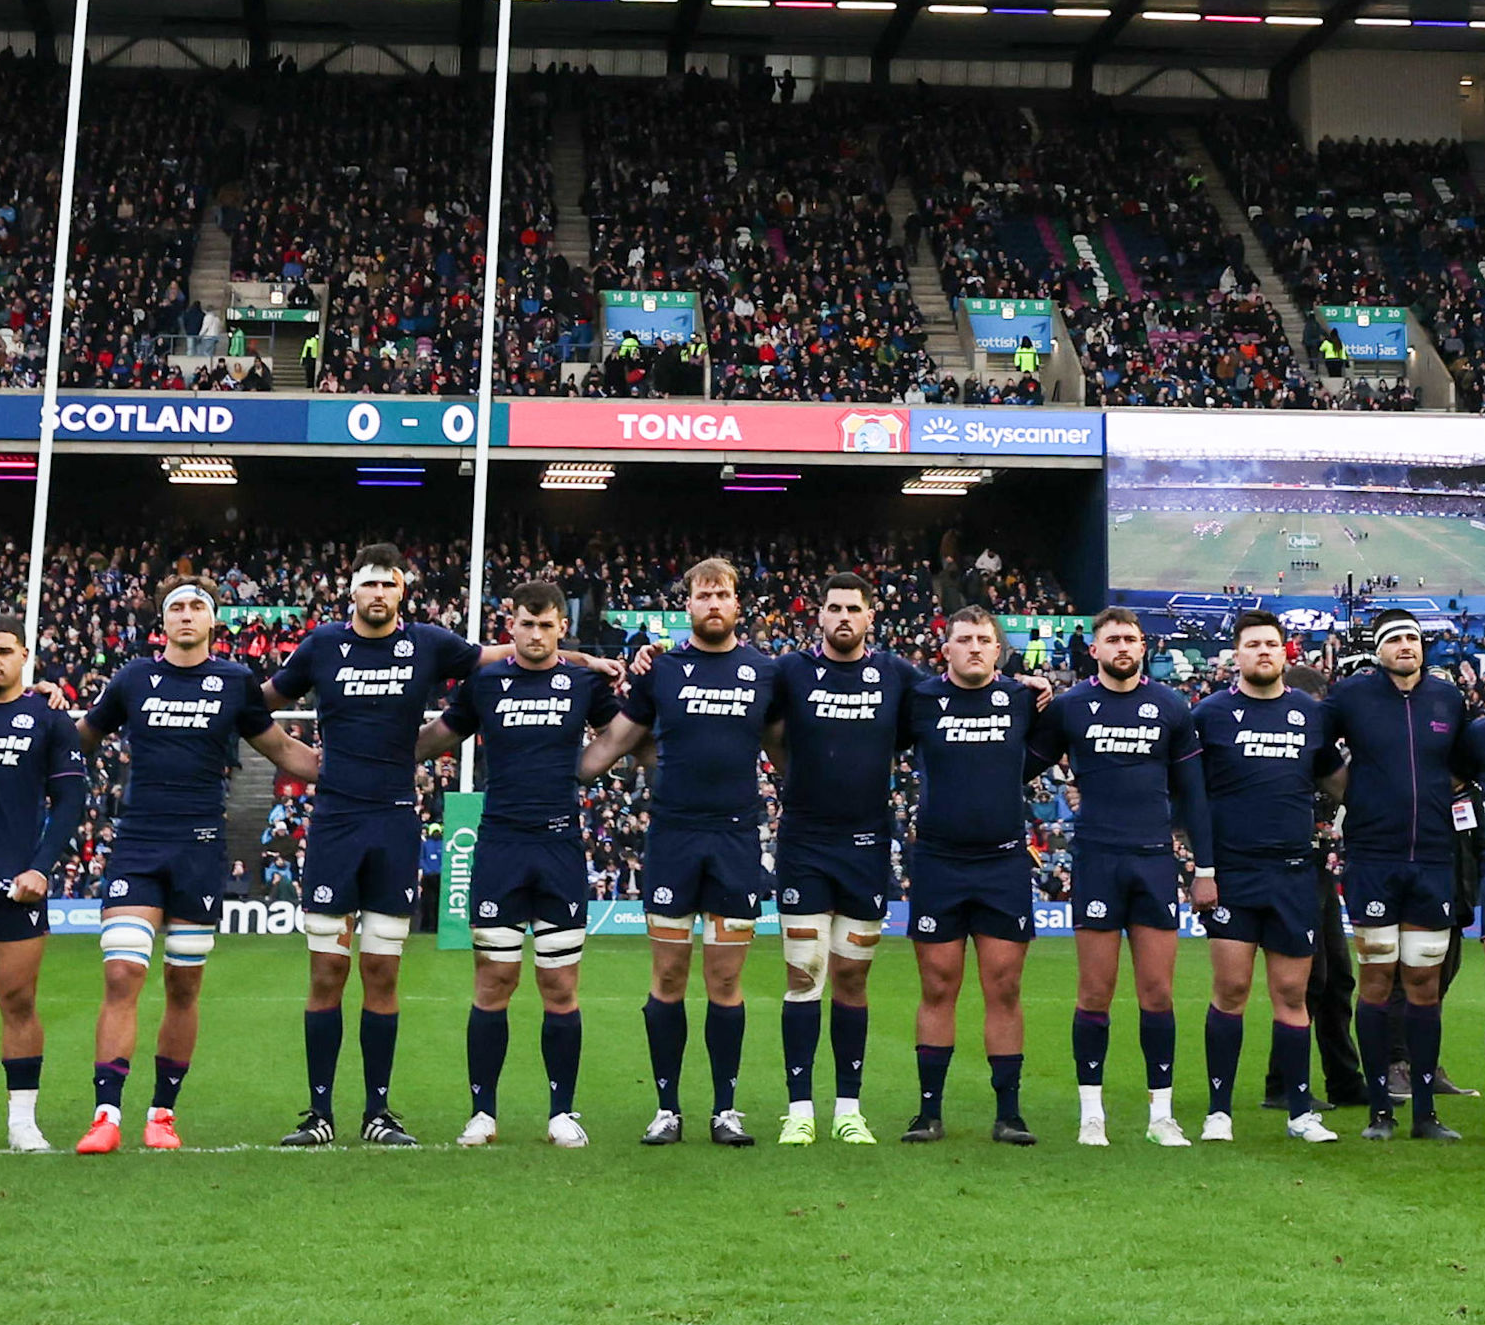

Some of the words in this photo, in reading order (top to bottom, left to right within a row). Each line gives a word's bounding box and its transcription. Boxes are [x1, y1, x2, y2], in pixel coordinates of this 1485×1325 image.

[613, 294, 623, 302] 16
[676, 294, 686, 303] 16
[262, 310, 284, 319] EXIT
[975, 336, 1016, 348] cottish
[347, 403, 380, 442] 0
[441, 404, 475, 443] 0
[617, 413, 742, 442] TONGA
[964, 421, 1091, 447] Skyscanner
[335, 665, 413, 683] Arnold
[343, 679, 406, 697] Clark
[677, 685, 755, 702] Arnold
[140, 697, 221, 715] Arnold
[494, 697, 571, 713] Arnold
[807, 689, 882, 706] Arnold
[685, 699, 748, 717] Clark
[815, 703, 876, 720] Clark
[147, 712, 211, 729] Clark
[502, 710, 564, 727] Clark
[936, 714, 1012, 730] Arnold
[945, 727, 1006, 743] Clark
[1085, 724, 1160, 742] Arnold
[1234, 729, 1306, 746] Arnold
[1094, 737, 1153, 755] Clark
[1242, 742, 1300, 759] Clark
[446, 827, 478, 919] Quilter
